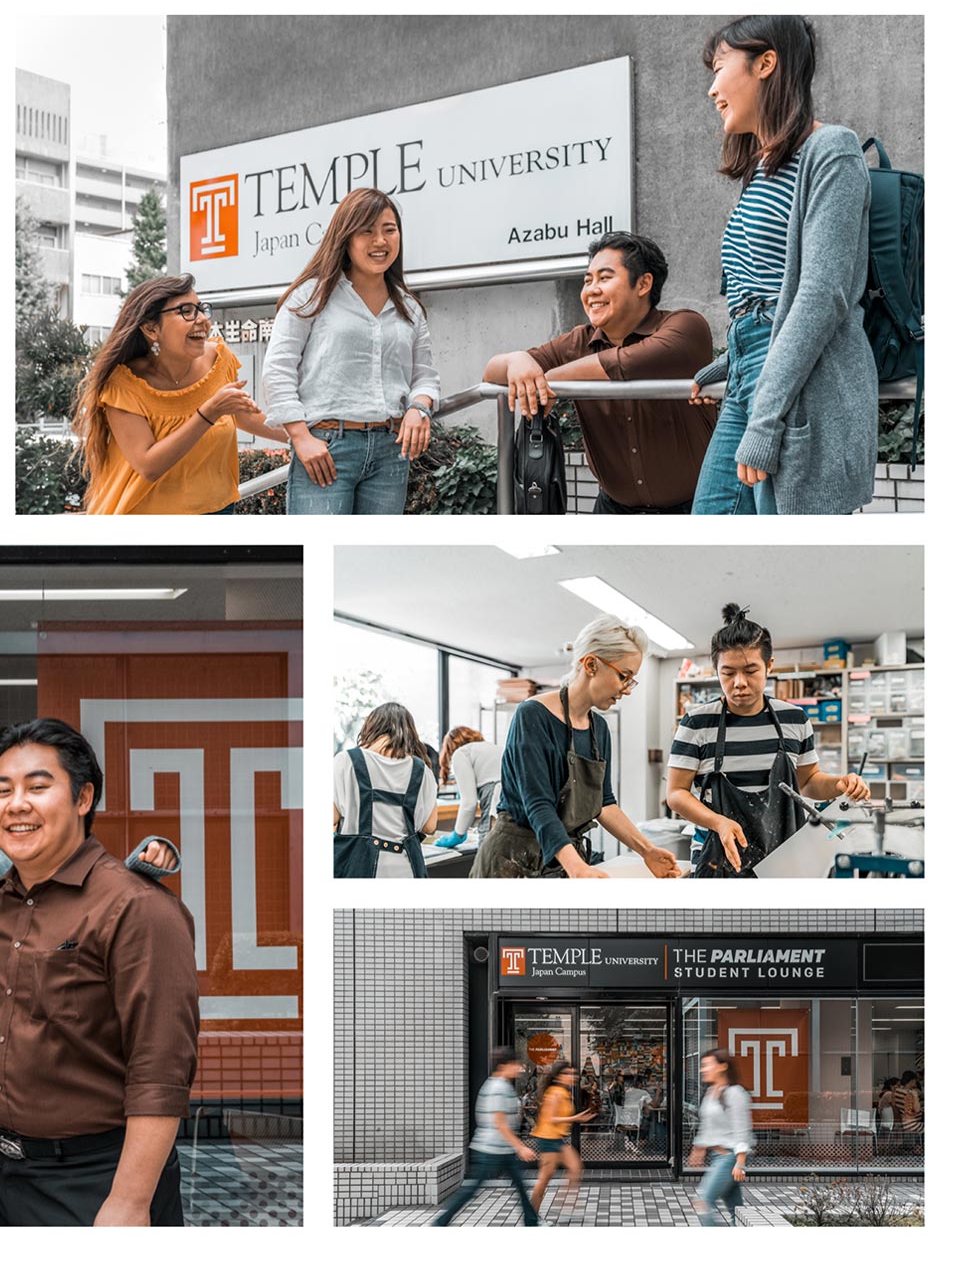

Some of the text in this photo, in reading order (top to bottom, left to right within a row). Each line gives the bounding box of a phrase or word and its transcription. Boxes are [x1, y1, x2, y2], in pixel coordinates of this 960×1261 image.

[244, 137, 613, 218] TEMPLE UNIVERSITY
[507, 215, 613, 244] Azabu Hall
[253, 230, 300, 258] Japan
[527, 948, 659, 966] TEMPLE UNIVERSITY
[673, 948, 826, 964] THE PARLIAMENT
[531, 967, 587, 978] Japan Campus
[674, 967, 825, 978] STUDENT LOUNGE
